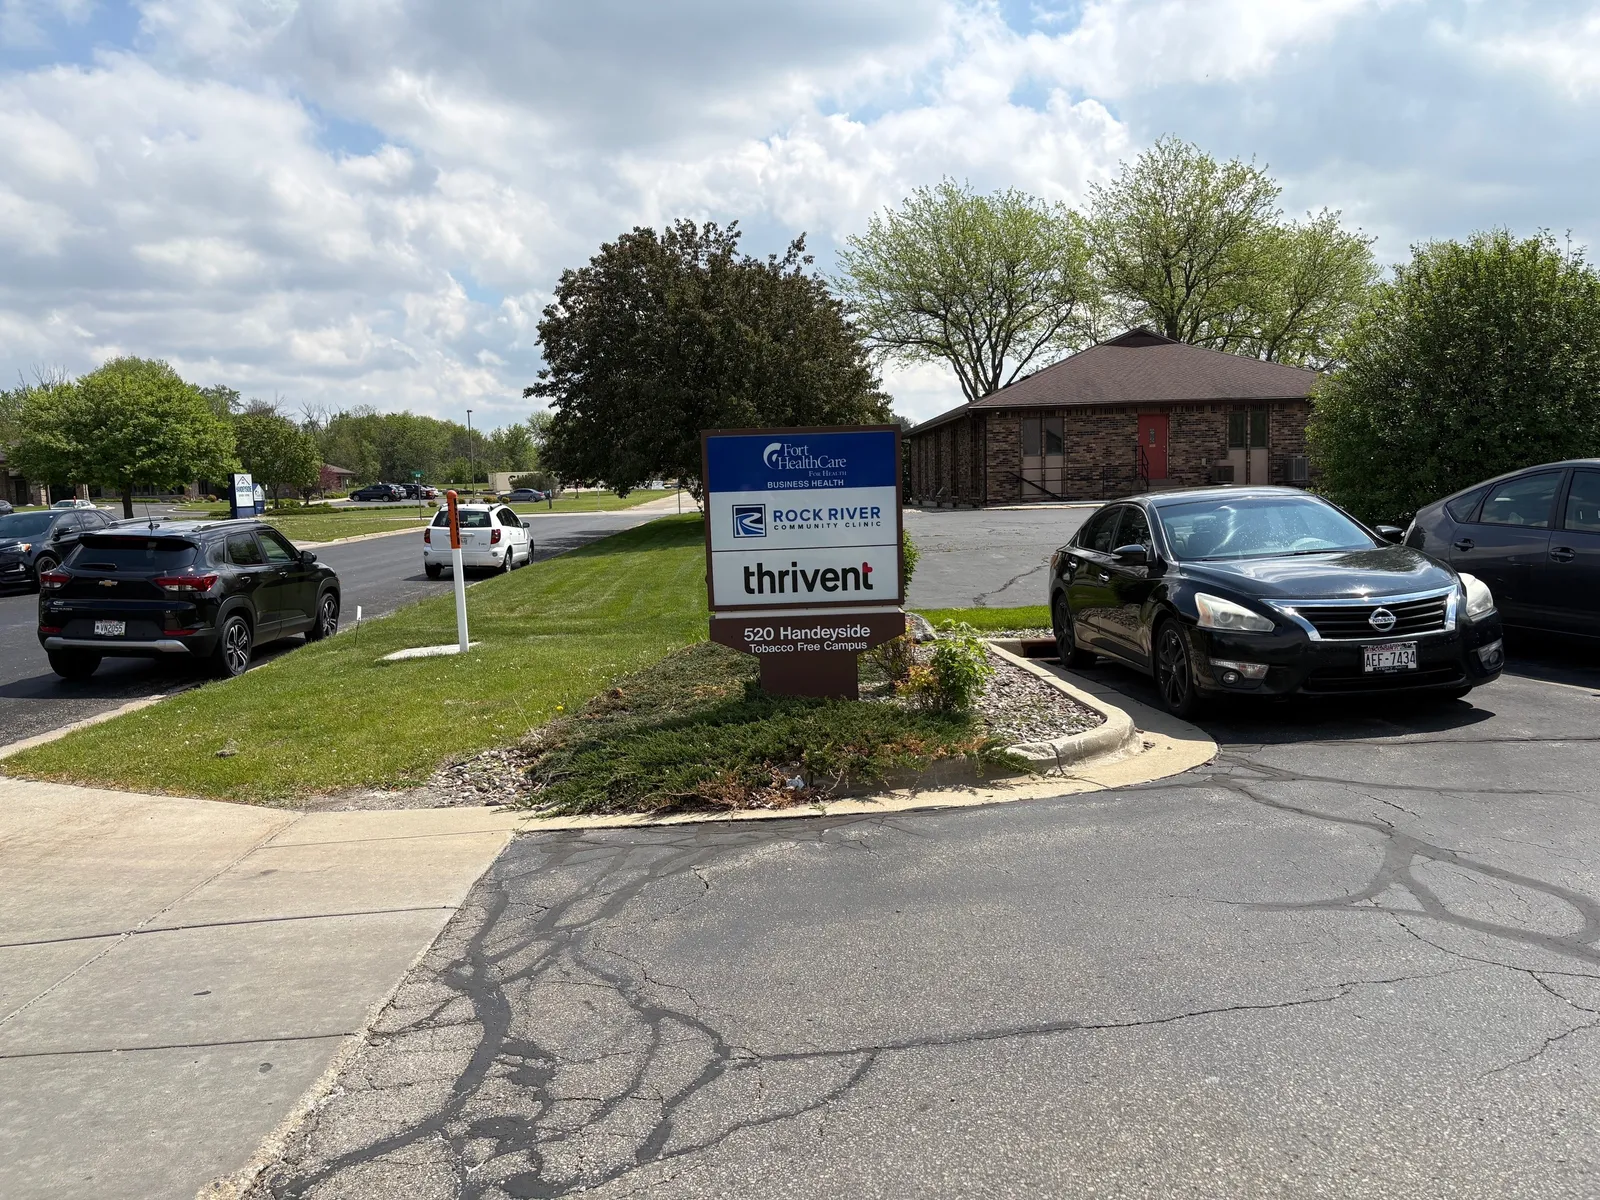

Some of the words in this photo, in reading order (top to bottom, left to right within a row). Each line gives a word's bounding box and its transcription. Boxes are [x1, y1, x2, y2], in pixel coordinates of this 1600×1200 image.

[783, 443, 809, 456] Fort
[778, 455, 847, 470] HealthCare
[767, 480, 809, 489] BUSINESS
[811, 479, 844, 487] HEALTH
[773, 509, 823, 522] ROCK
[828, 506, 881, 519] RIVER
[773, 523, 839, 531] COMMUNITY
[743, 561, 873, 594] thrivent
[744, 627, 775, 641] 520
[780, 624, 871, 642] Handeyside
[749, 643, 794, 654] Tobacco
[797, 642, 821, 651] Free
[823, 640, 868, 652] Campus
[1365, 651, 1416, 667] AEF-7434
